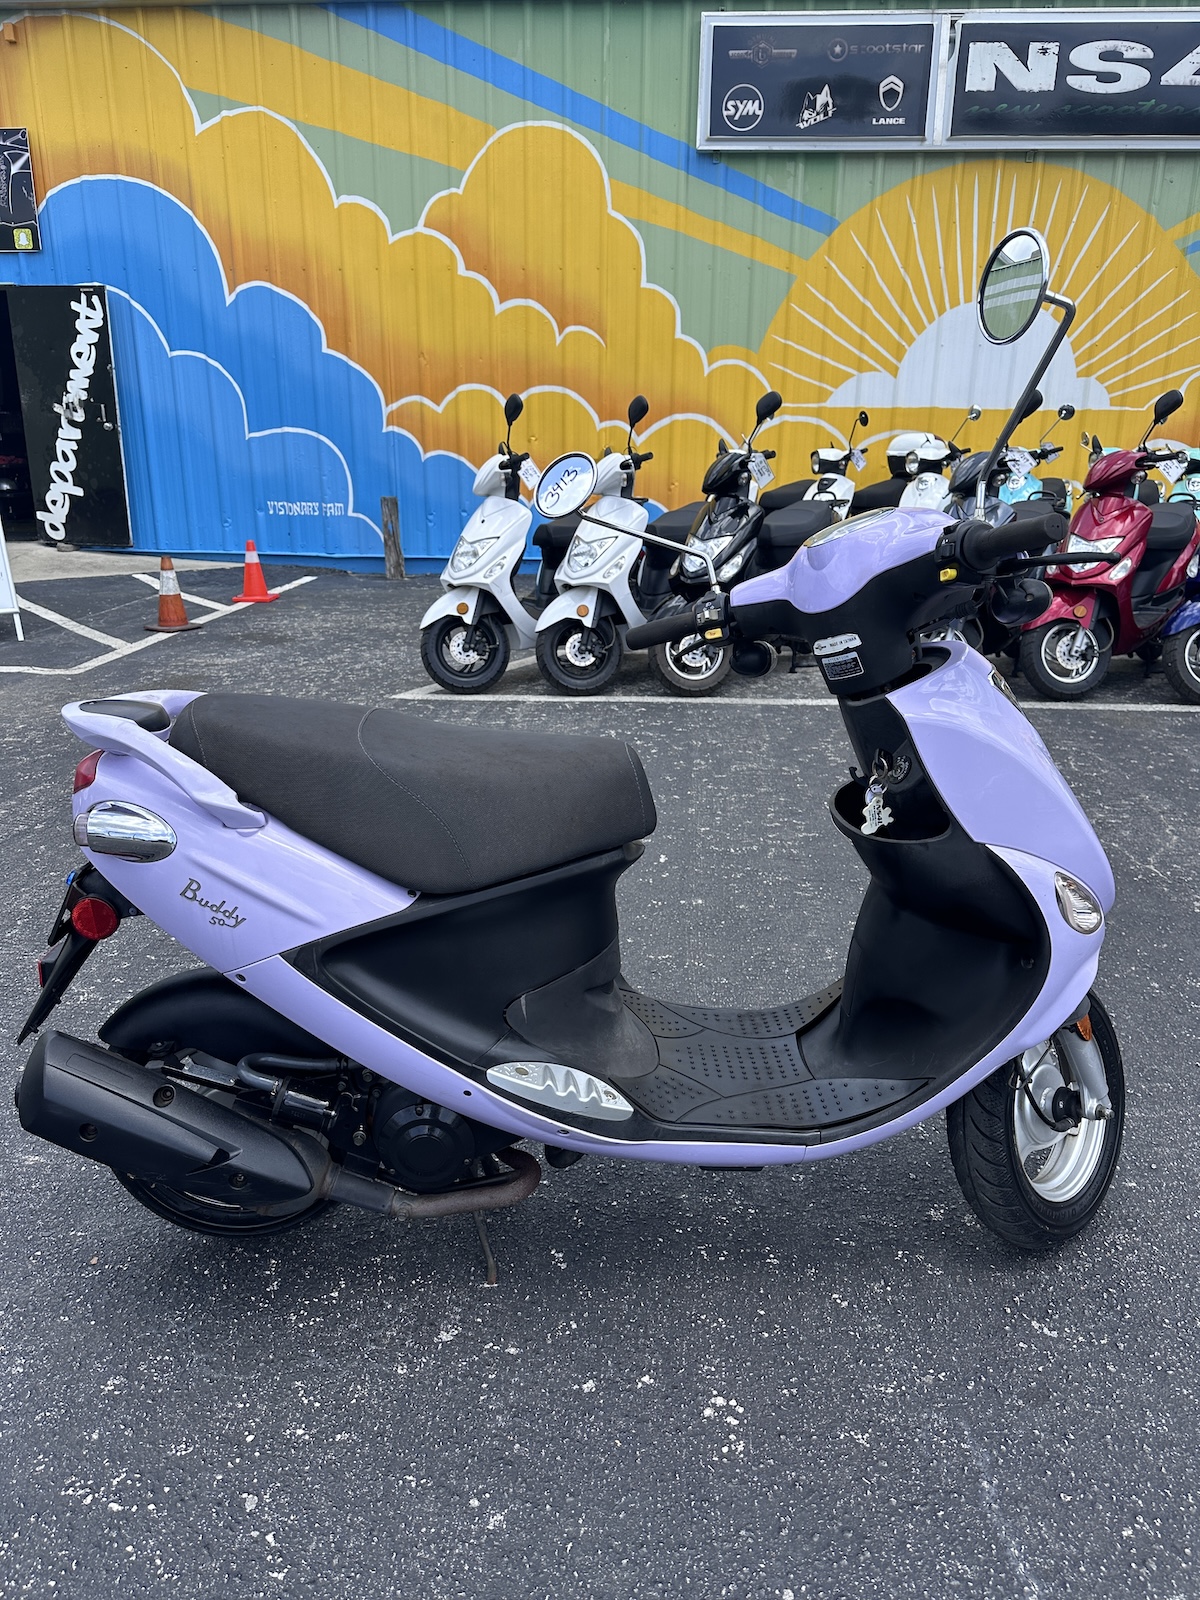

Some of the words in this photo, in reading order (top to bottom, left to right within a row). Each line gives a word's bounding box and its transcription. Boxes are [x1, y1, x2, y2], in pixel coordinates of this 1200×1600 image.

[725, 99, 762, 121] SYM
[796, 107, 837, 129] WOLF
[965, 103, 1041, 114] new
[872, 117, 906, 125] LANCE
[36, 292, 104, 541] department
[544, 469, 578, 509] 3413
[266, 500, 319, 516] VISIONARY
[321, 502, 345, 516] FAM
[180, 877, 247, 929] Buddy
[208, 915, 226, 927] 50
